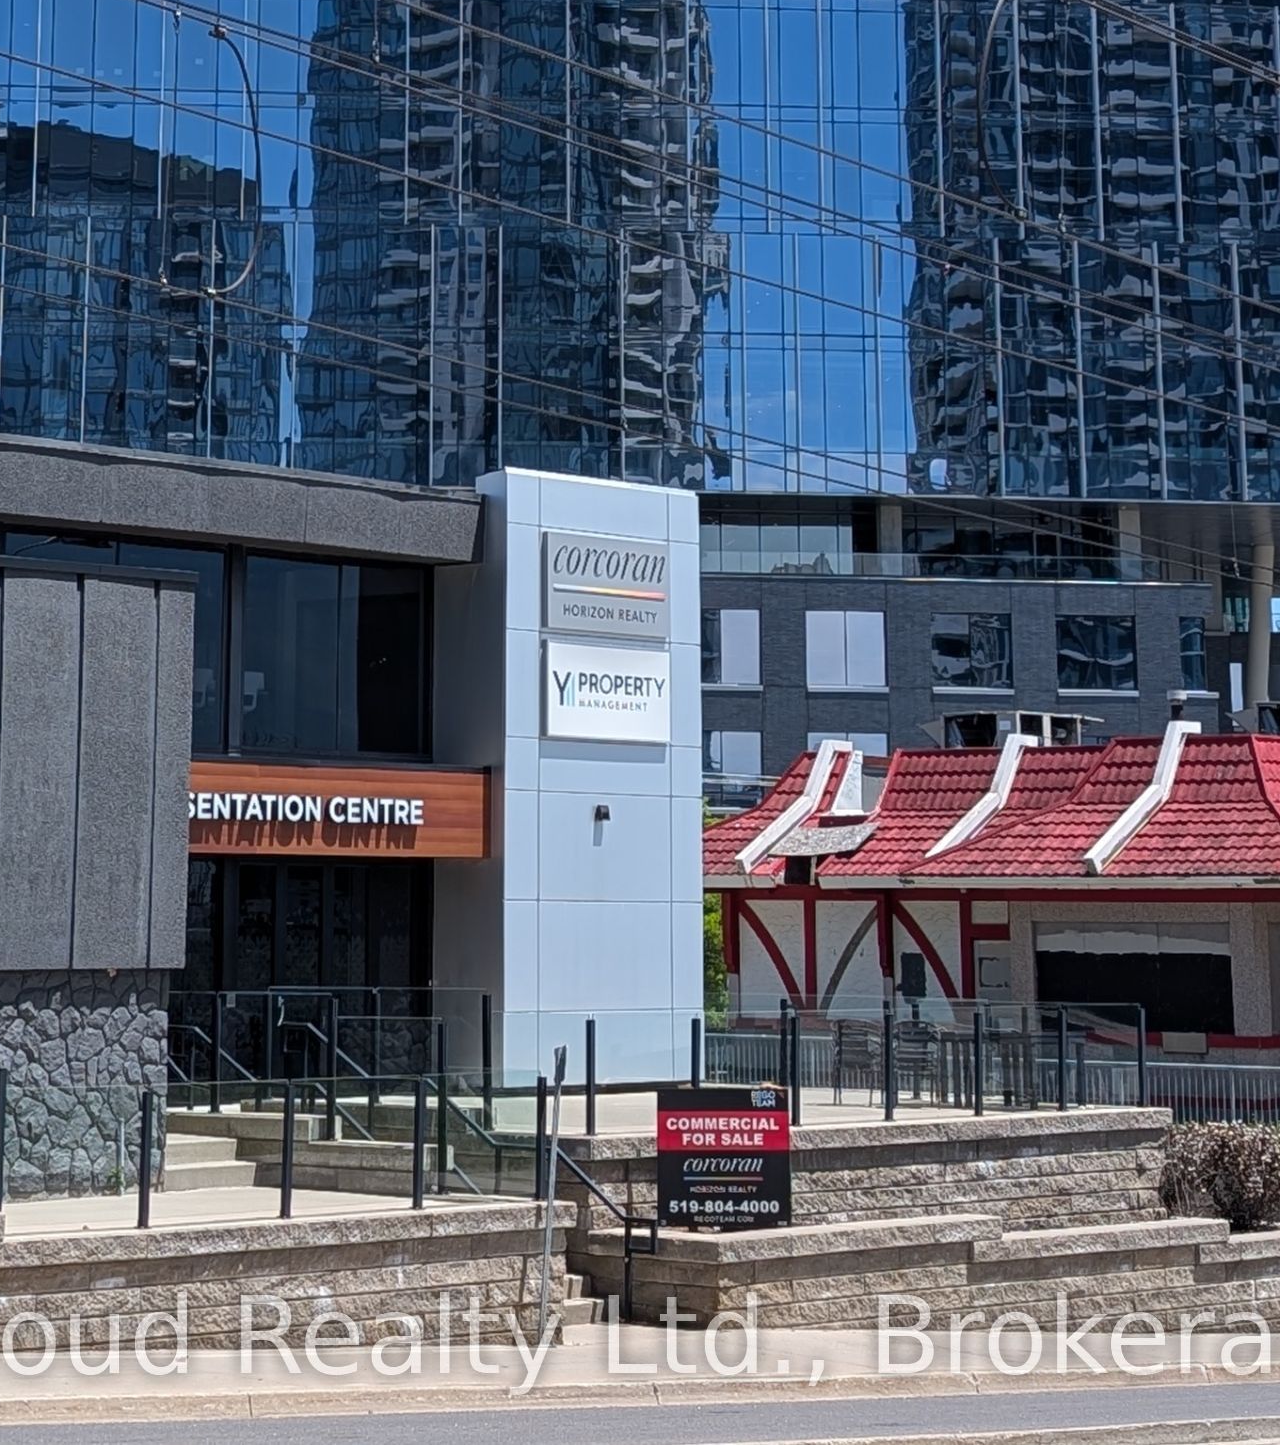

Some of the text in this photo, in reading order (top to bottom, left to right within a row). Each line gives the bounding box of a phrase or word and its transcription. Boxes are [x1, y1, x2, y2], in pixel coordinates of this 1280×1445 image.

[553, 545, 666, 584] corcoran
[562, 604, 658, 624] HORIZON REALTY
[578, 671, 666, 698] PROPERTY
[578, 698, 648, 713] MANAGEMENT
[328, 796, 424, 825] CENTRE
[665, 1117, 780, 1131] COMMERCIAL
[682, 1133, 765, 1146] FOR SALE
[683, 1157, 764, 1172] corcoran
[668, 1199, 781, 1213] 519-804-4000
